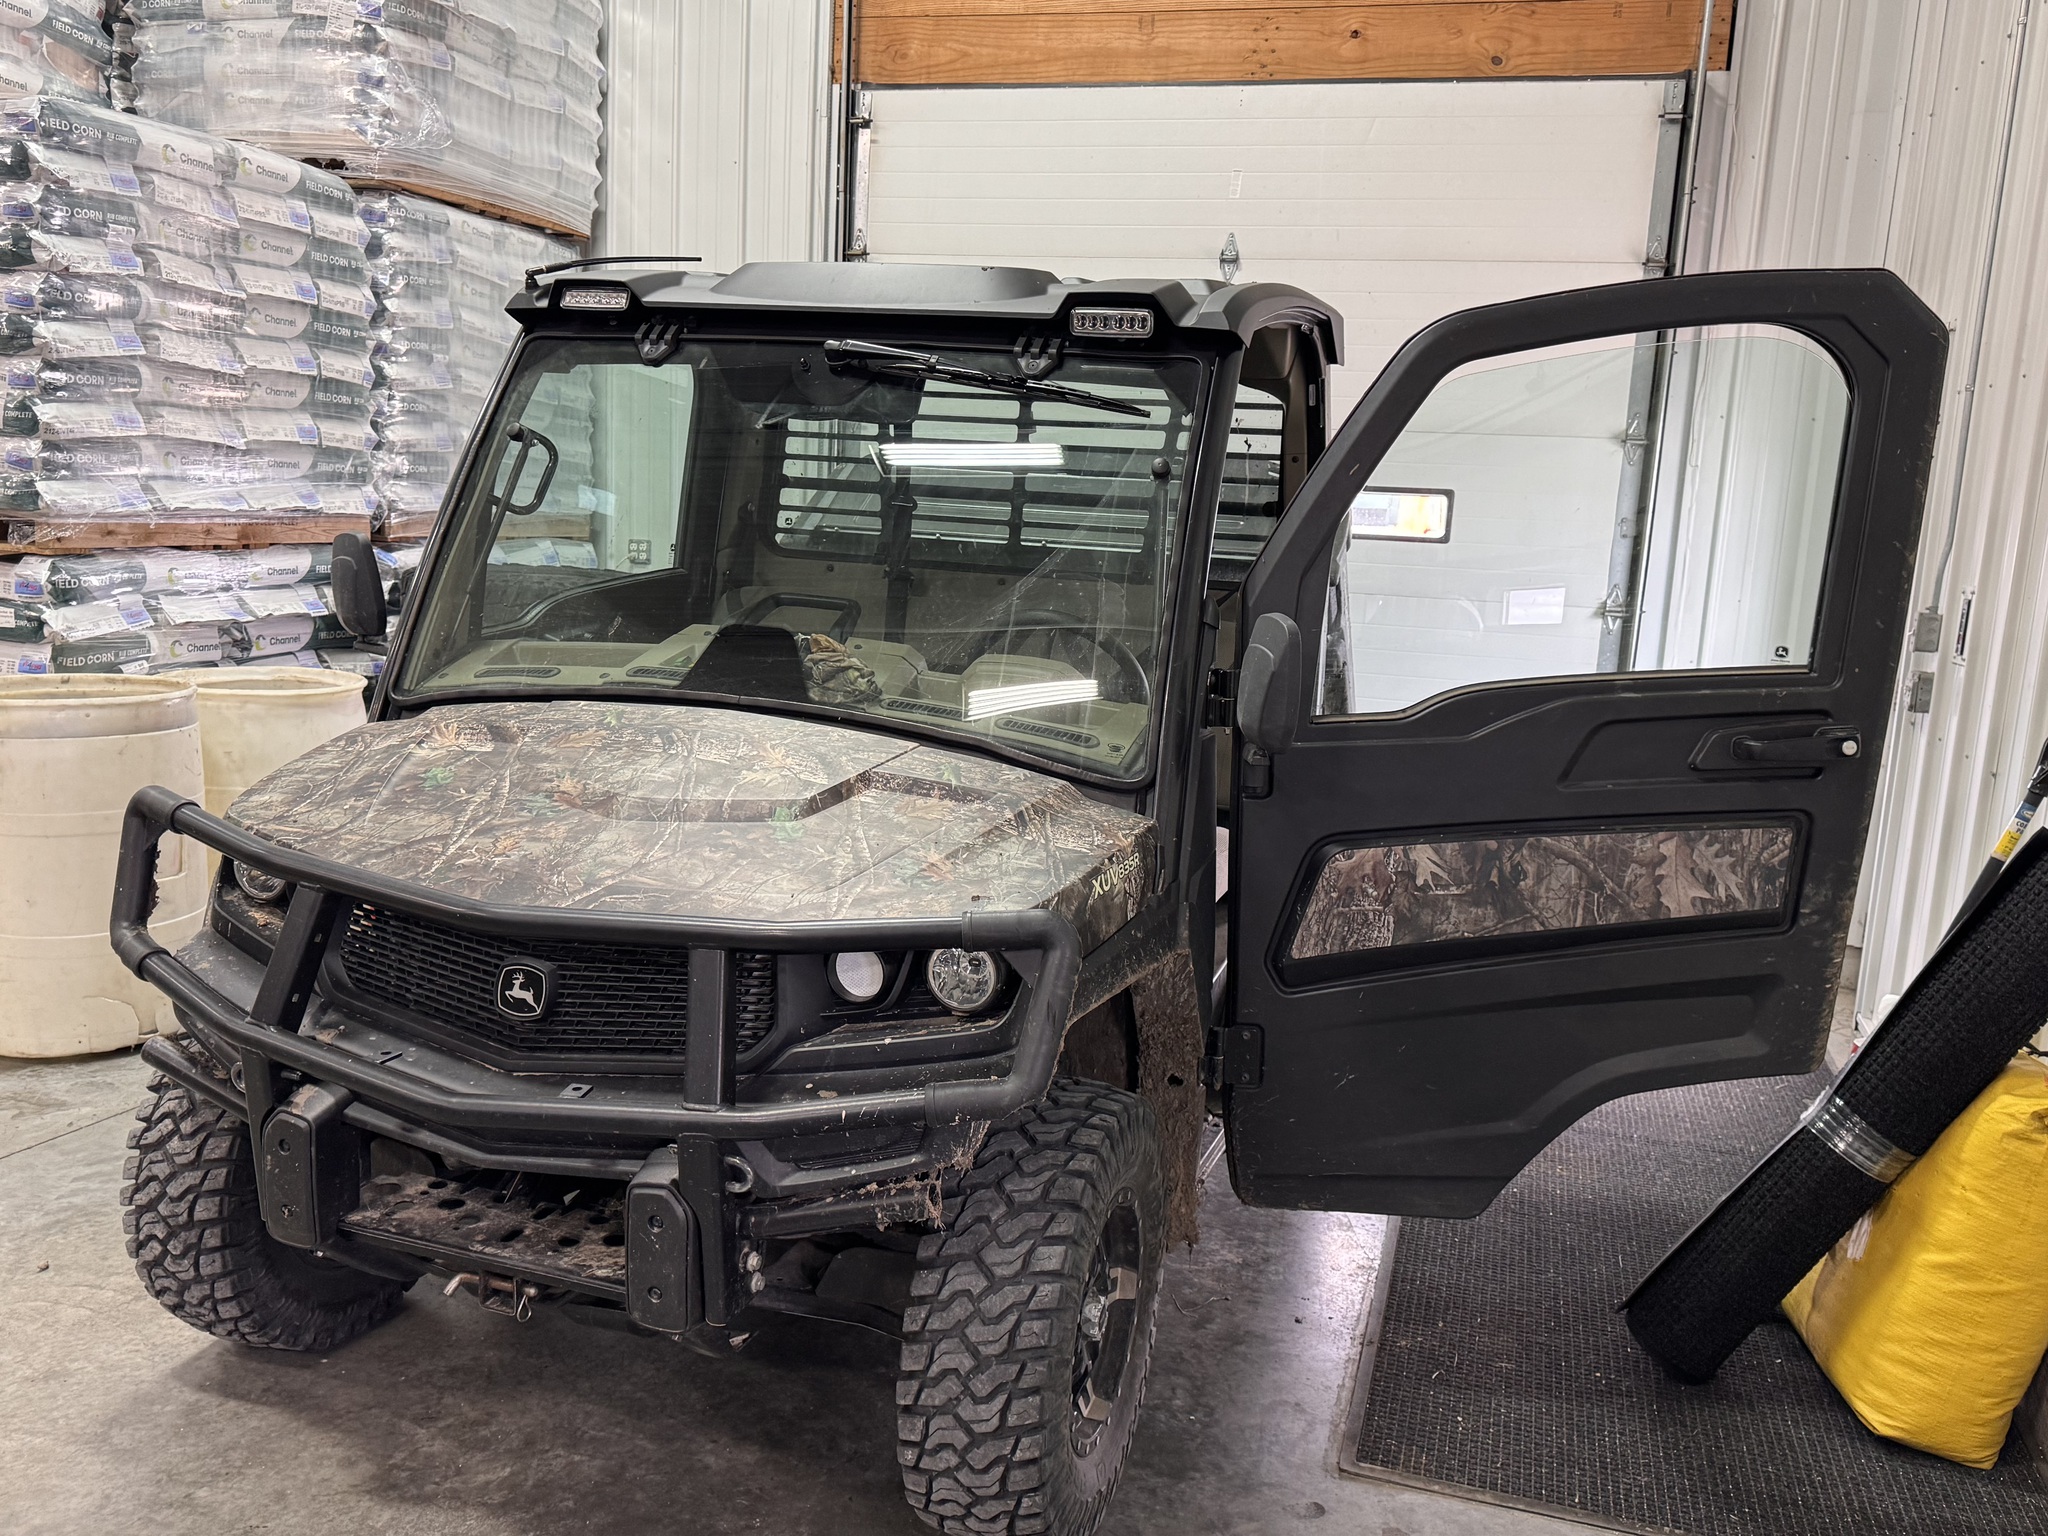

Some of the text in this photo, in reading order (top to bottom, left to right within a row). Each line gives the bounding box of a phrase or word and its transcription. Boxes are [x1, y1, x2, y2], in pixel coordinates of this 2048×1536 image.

[0, 0, 32, 18] hannel
[386, 2, 407, 14] IELD
[52, 20, 72, 35] FIELD
[72, 30, 94, 46] CORN
[237, 29, 273, 39] Channel
[294, 30, 315, 38] FIELD
[0, 74, 28, 92] hannel
[43, 117, 70, 131] IELD
[72, 123, 102, 139] CORN
[180, 152, 214, 172] Channe
[256, 165, 289, 183] Channel
[306, 181, 323, 193] FIELD
[323, 186, 343, 200] CORN
[73, 208, 103, 221] CORN
[115, 214, 136, 224] COMPLETE
[261, 240, 294, 256] Channel
[311, 251, 328, 263] FIELD
[329, 256, 349, 268] CORN
[264, 313, 297, 328] Channel
[314, 321, 331, 333] FIELD
[331, 326, 351, 338] CORN
[76, 374, 105, 386] CORN
[265, 386, 297, 398] Channel
[314, 391, 331, 401] FIELD
[332, 394, 352, 405] CORN
[4, 410, 33, 419] COMPLETE
[267, 459, 300, 470] Channel
[317, 462, 334, 471] FIELD
[267, 566, 299, 577] Channel
[54, 578, 79, 589] IELD
[269, 634, 301, 646] Channel
[57, 656, 85, 667] FIELD
[87, 651, 115, 664] CORN
[1091, 852, 1141, 900] XUV835R
